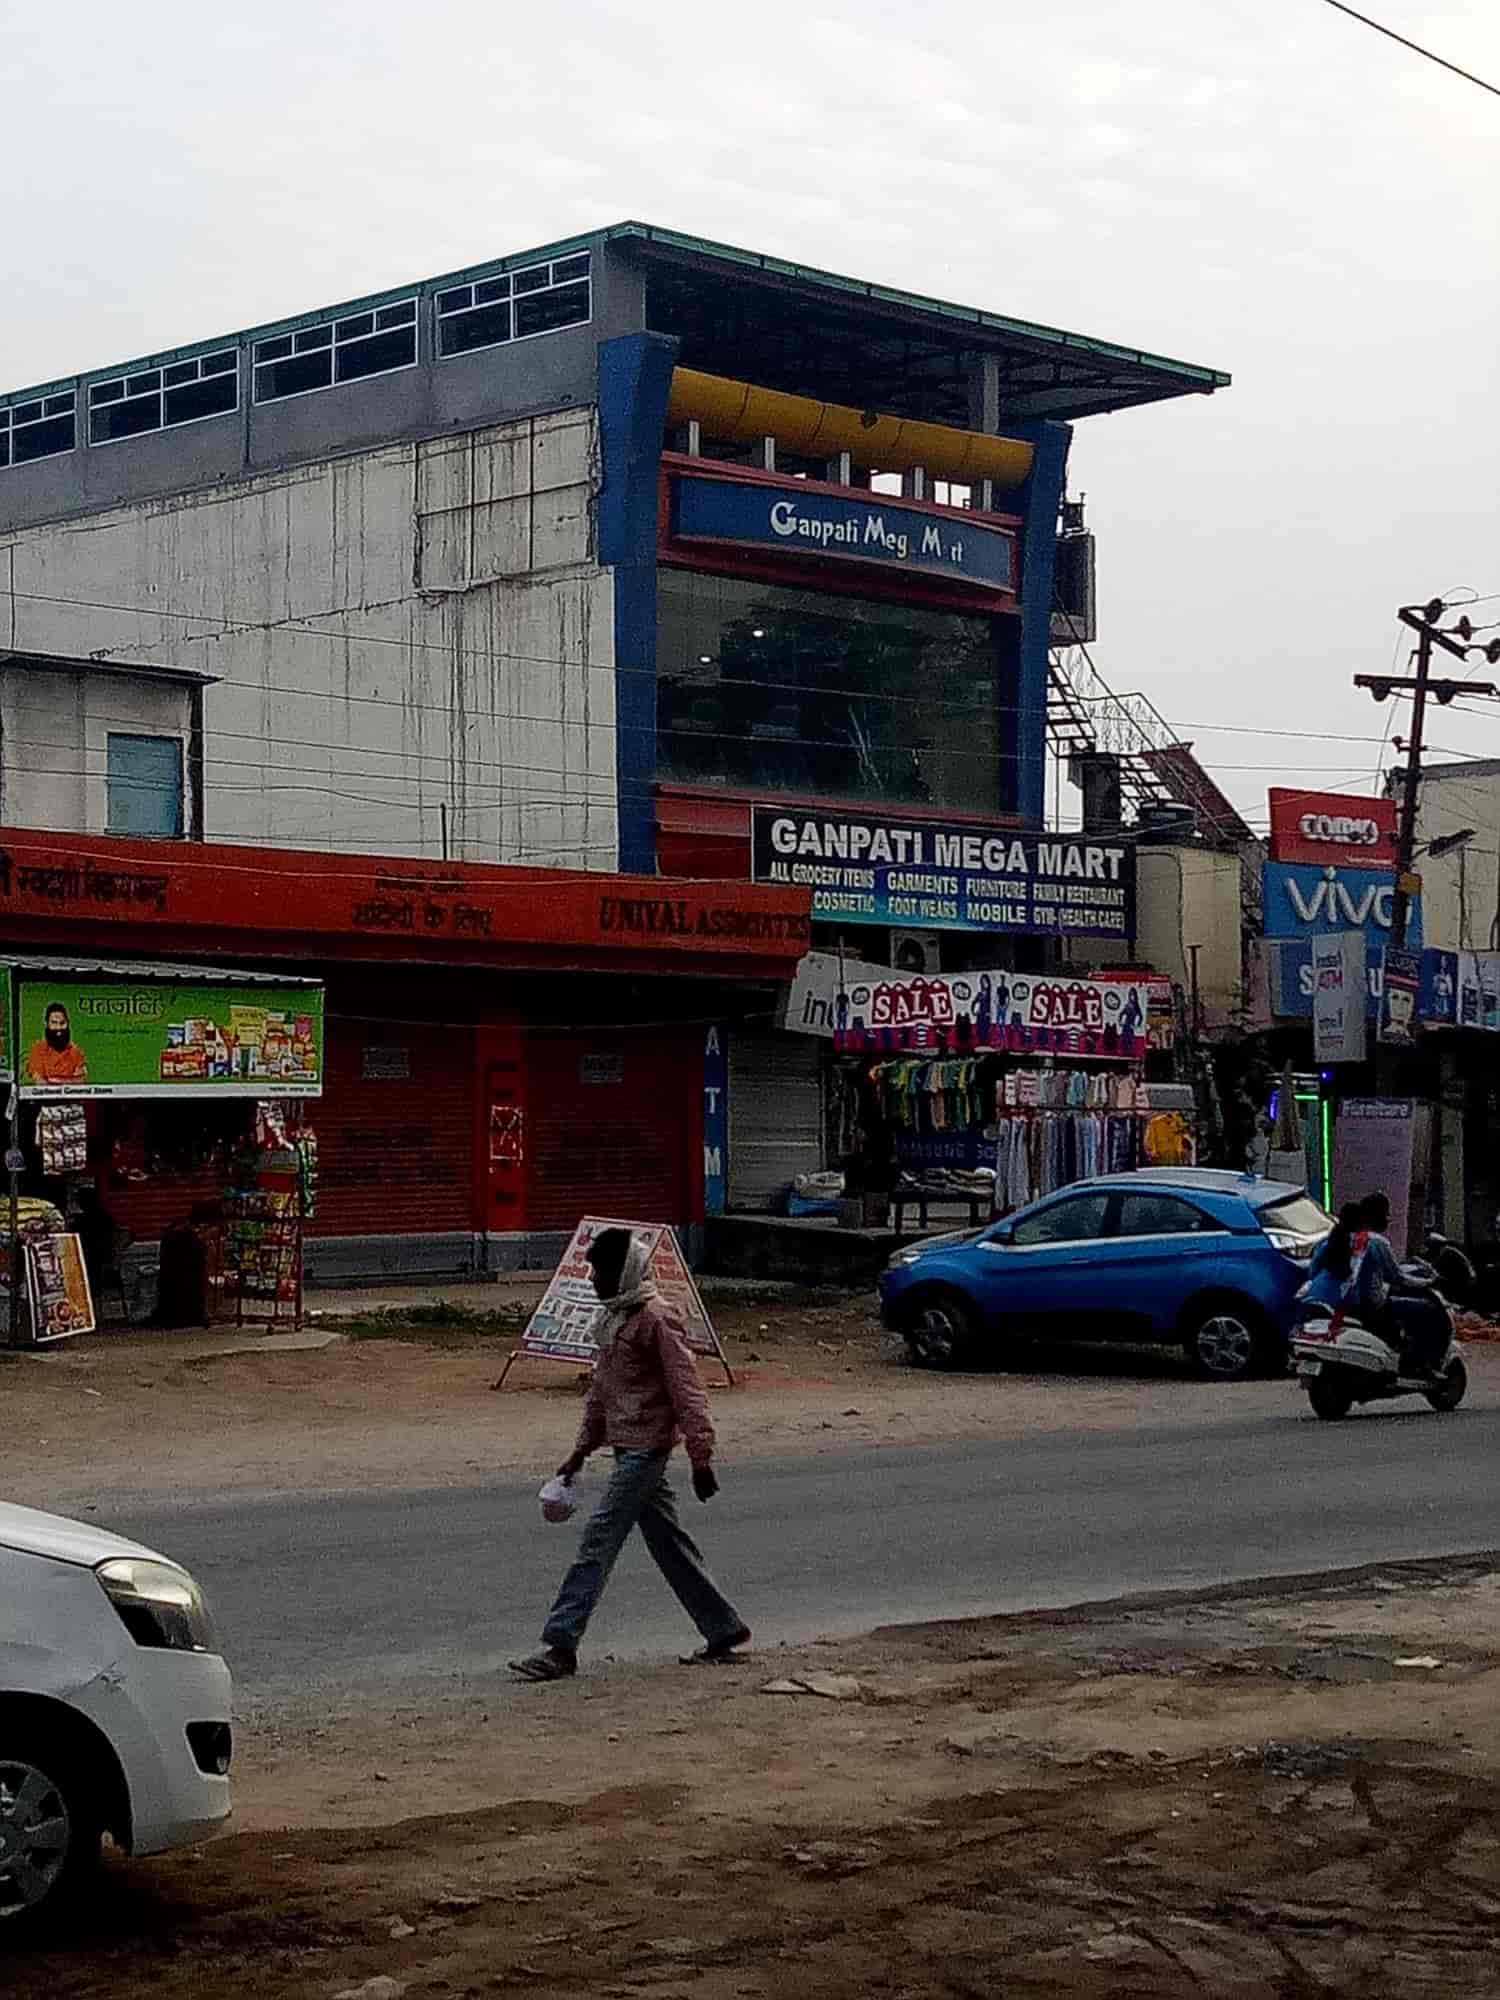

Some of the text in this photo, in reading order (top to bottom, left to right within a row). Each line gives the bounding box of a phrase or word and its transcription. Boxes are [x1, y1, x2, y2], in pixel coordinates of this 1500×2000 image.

[770, 500, 964, 562] Ganpati Meg Mrt
[771, 818, 1124, 880] GANPATI MEGA MART
[770, 861, 790, 882] ALL
[792, 863, 841, 886] GROCERY
[843, 868, 875, 889] ITEMS
[887, 872, 958, 895] GARMENTS
[966, 878, 1027, 900] FURNITURE
[814, 891, 875, 913] COSMETIC
[888, 896, 918, 916] FOOT
[920, 900, 958, 919] WEARS
[967, 903, 1027, 924] MOBILE
[874, 987, 950, 1021] SALE
[1032, 992, 1102, 1022] SALE
[705, 1024, 721, 1177] ATM
